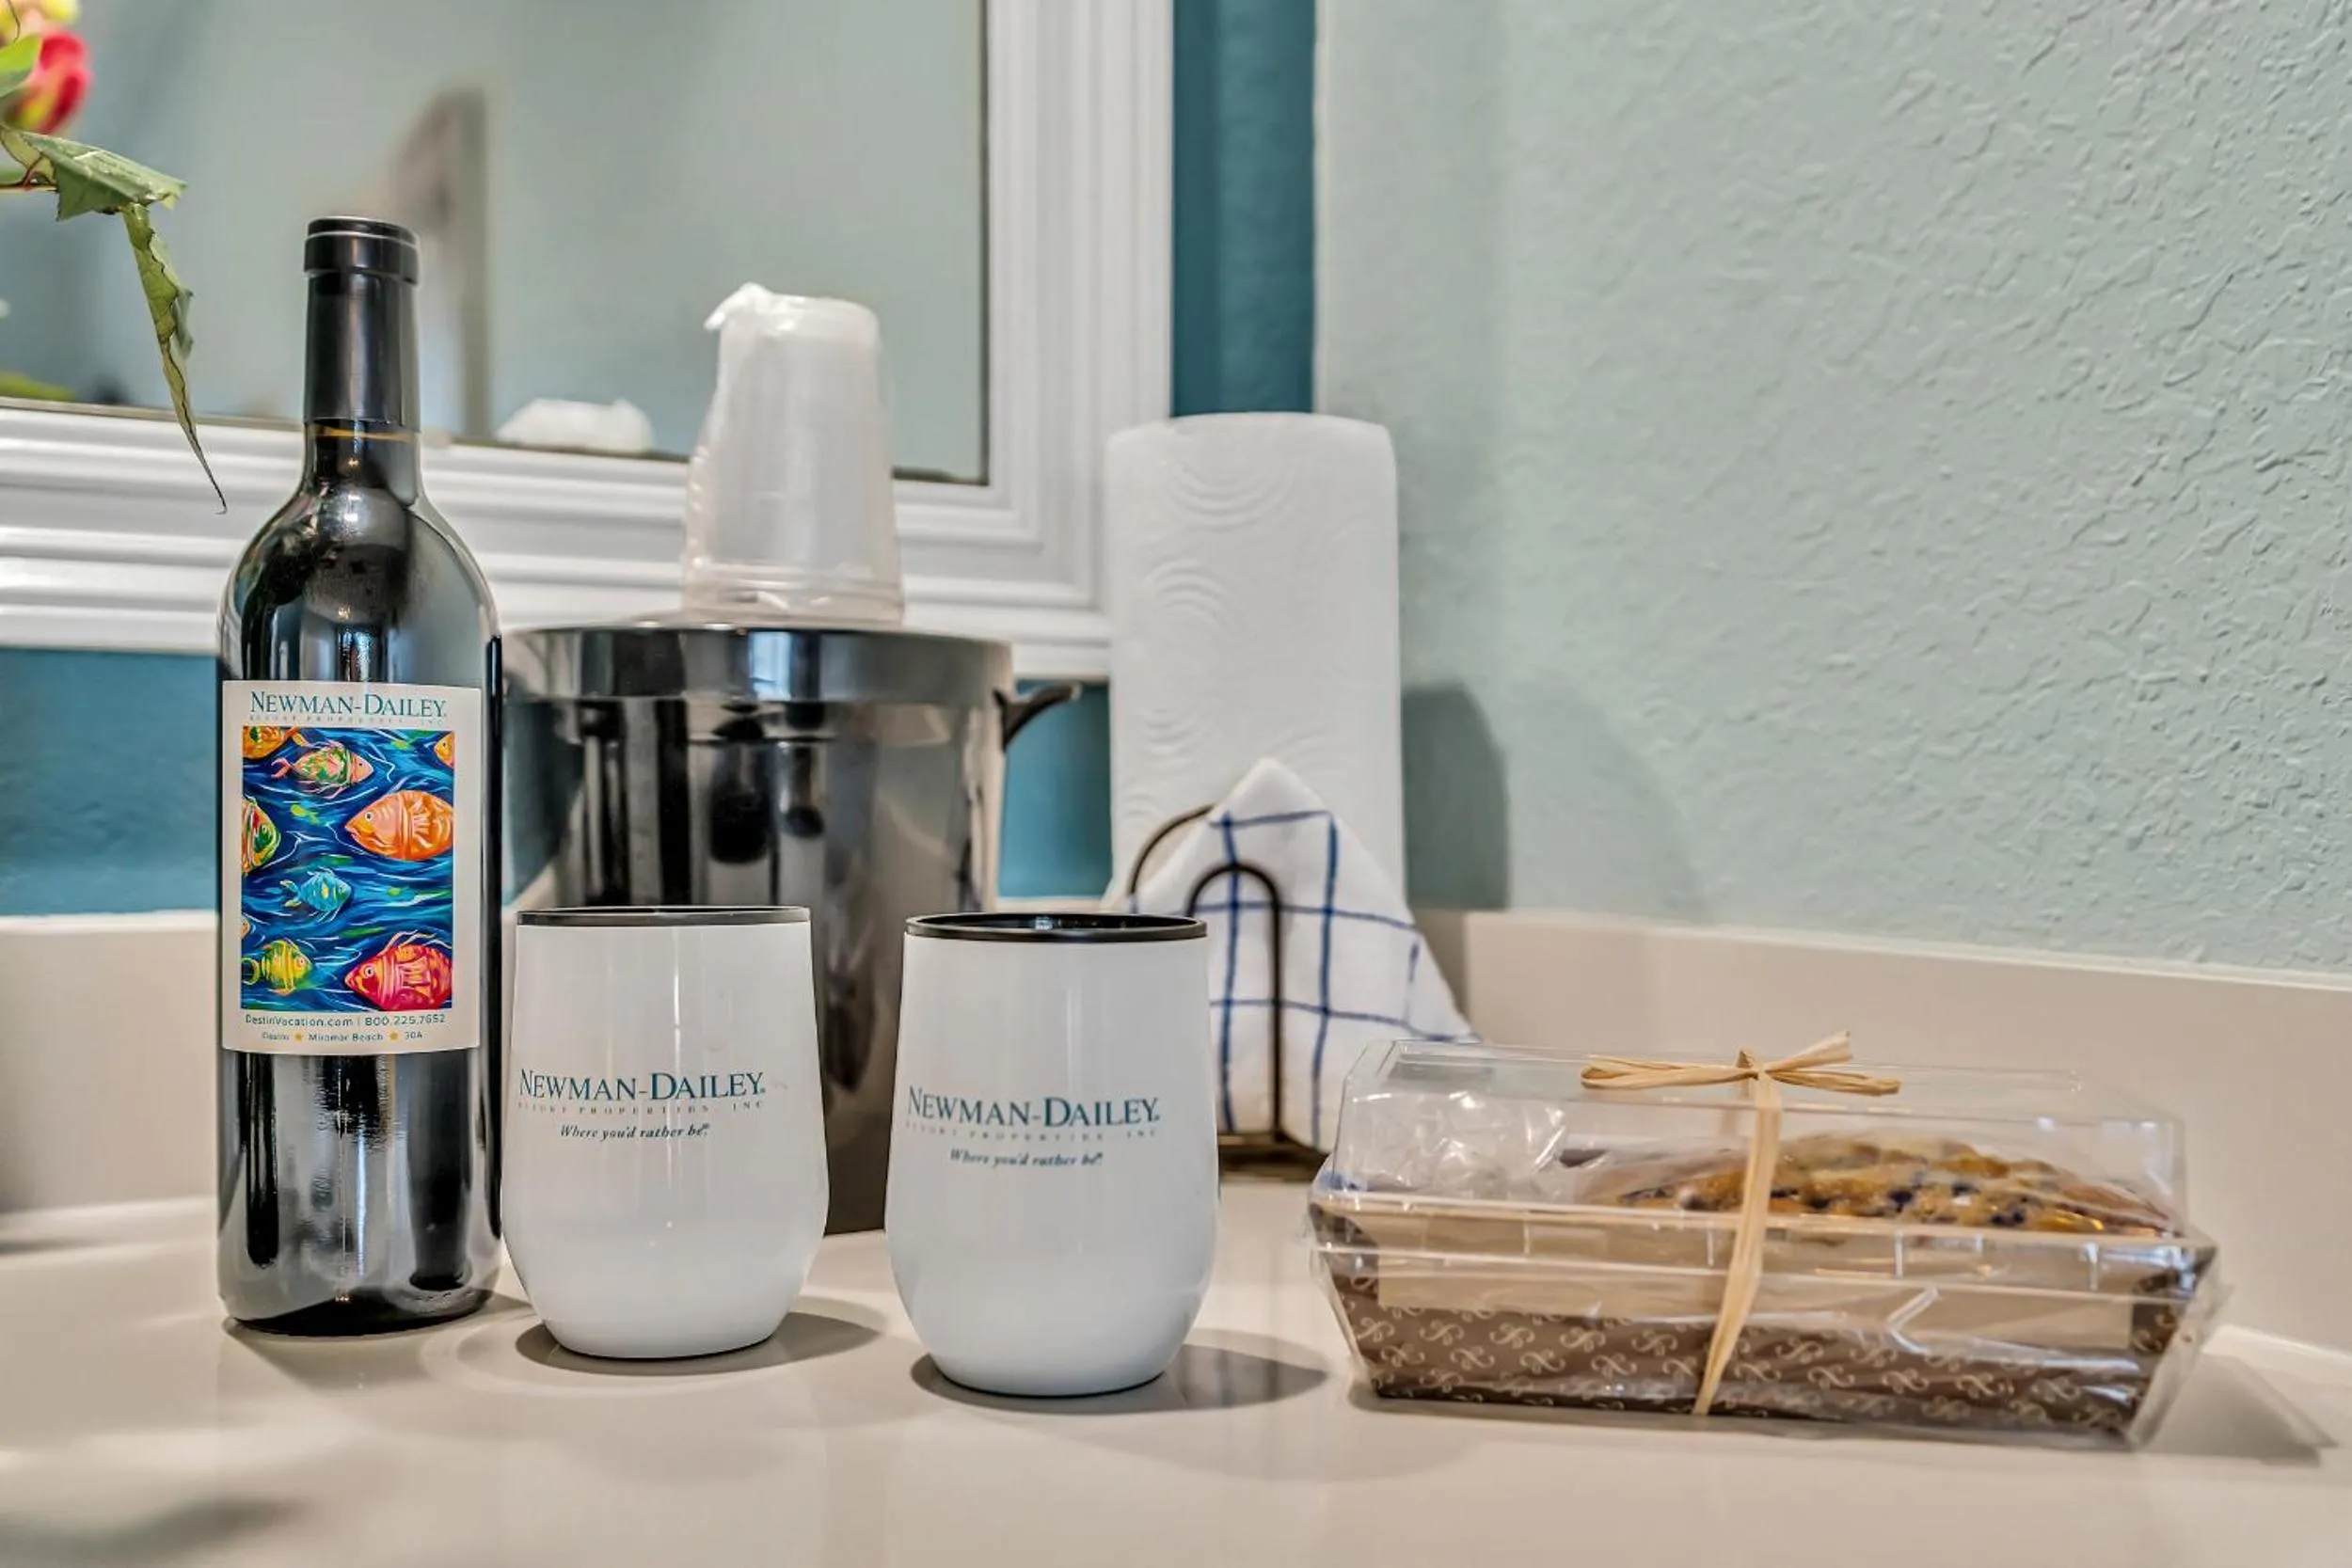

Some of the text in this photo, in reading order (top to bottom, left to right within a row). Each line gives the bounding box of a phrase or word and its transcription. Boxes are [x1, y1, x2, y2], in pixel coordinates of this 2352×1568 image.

[250, 690, 446, 718] NEWMAN-DAILEY
[246, 1013, 353, 1027] DestinVacation.com
[352, 1032, 384, 1042] Beach
[519, 1068, 766, 1101] NEWMAN-DAILEY
[907, 1085, 1160, 1128] NEWMAN-DAILEY
[561, 1123, 598, 1138] Where
[599, 1125, 637, 1142] you'd
[639, 1125, 683, 1138] rather
[950, 1148, 990, 1164] Where
[1031, 1152, 1078, 1166] rather
